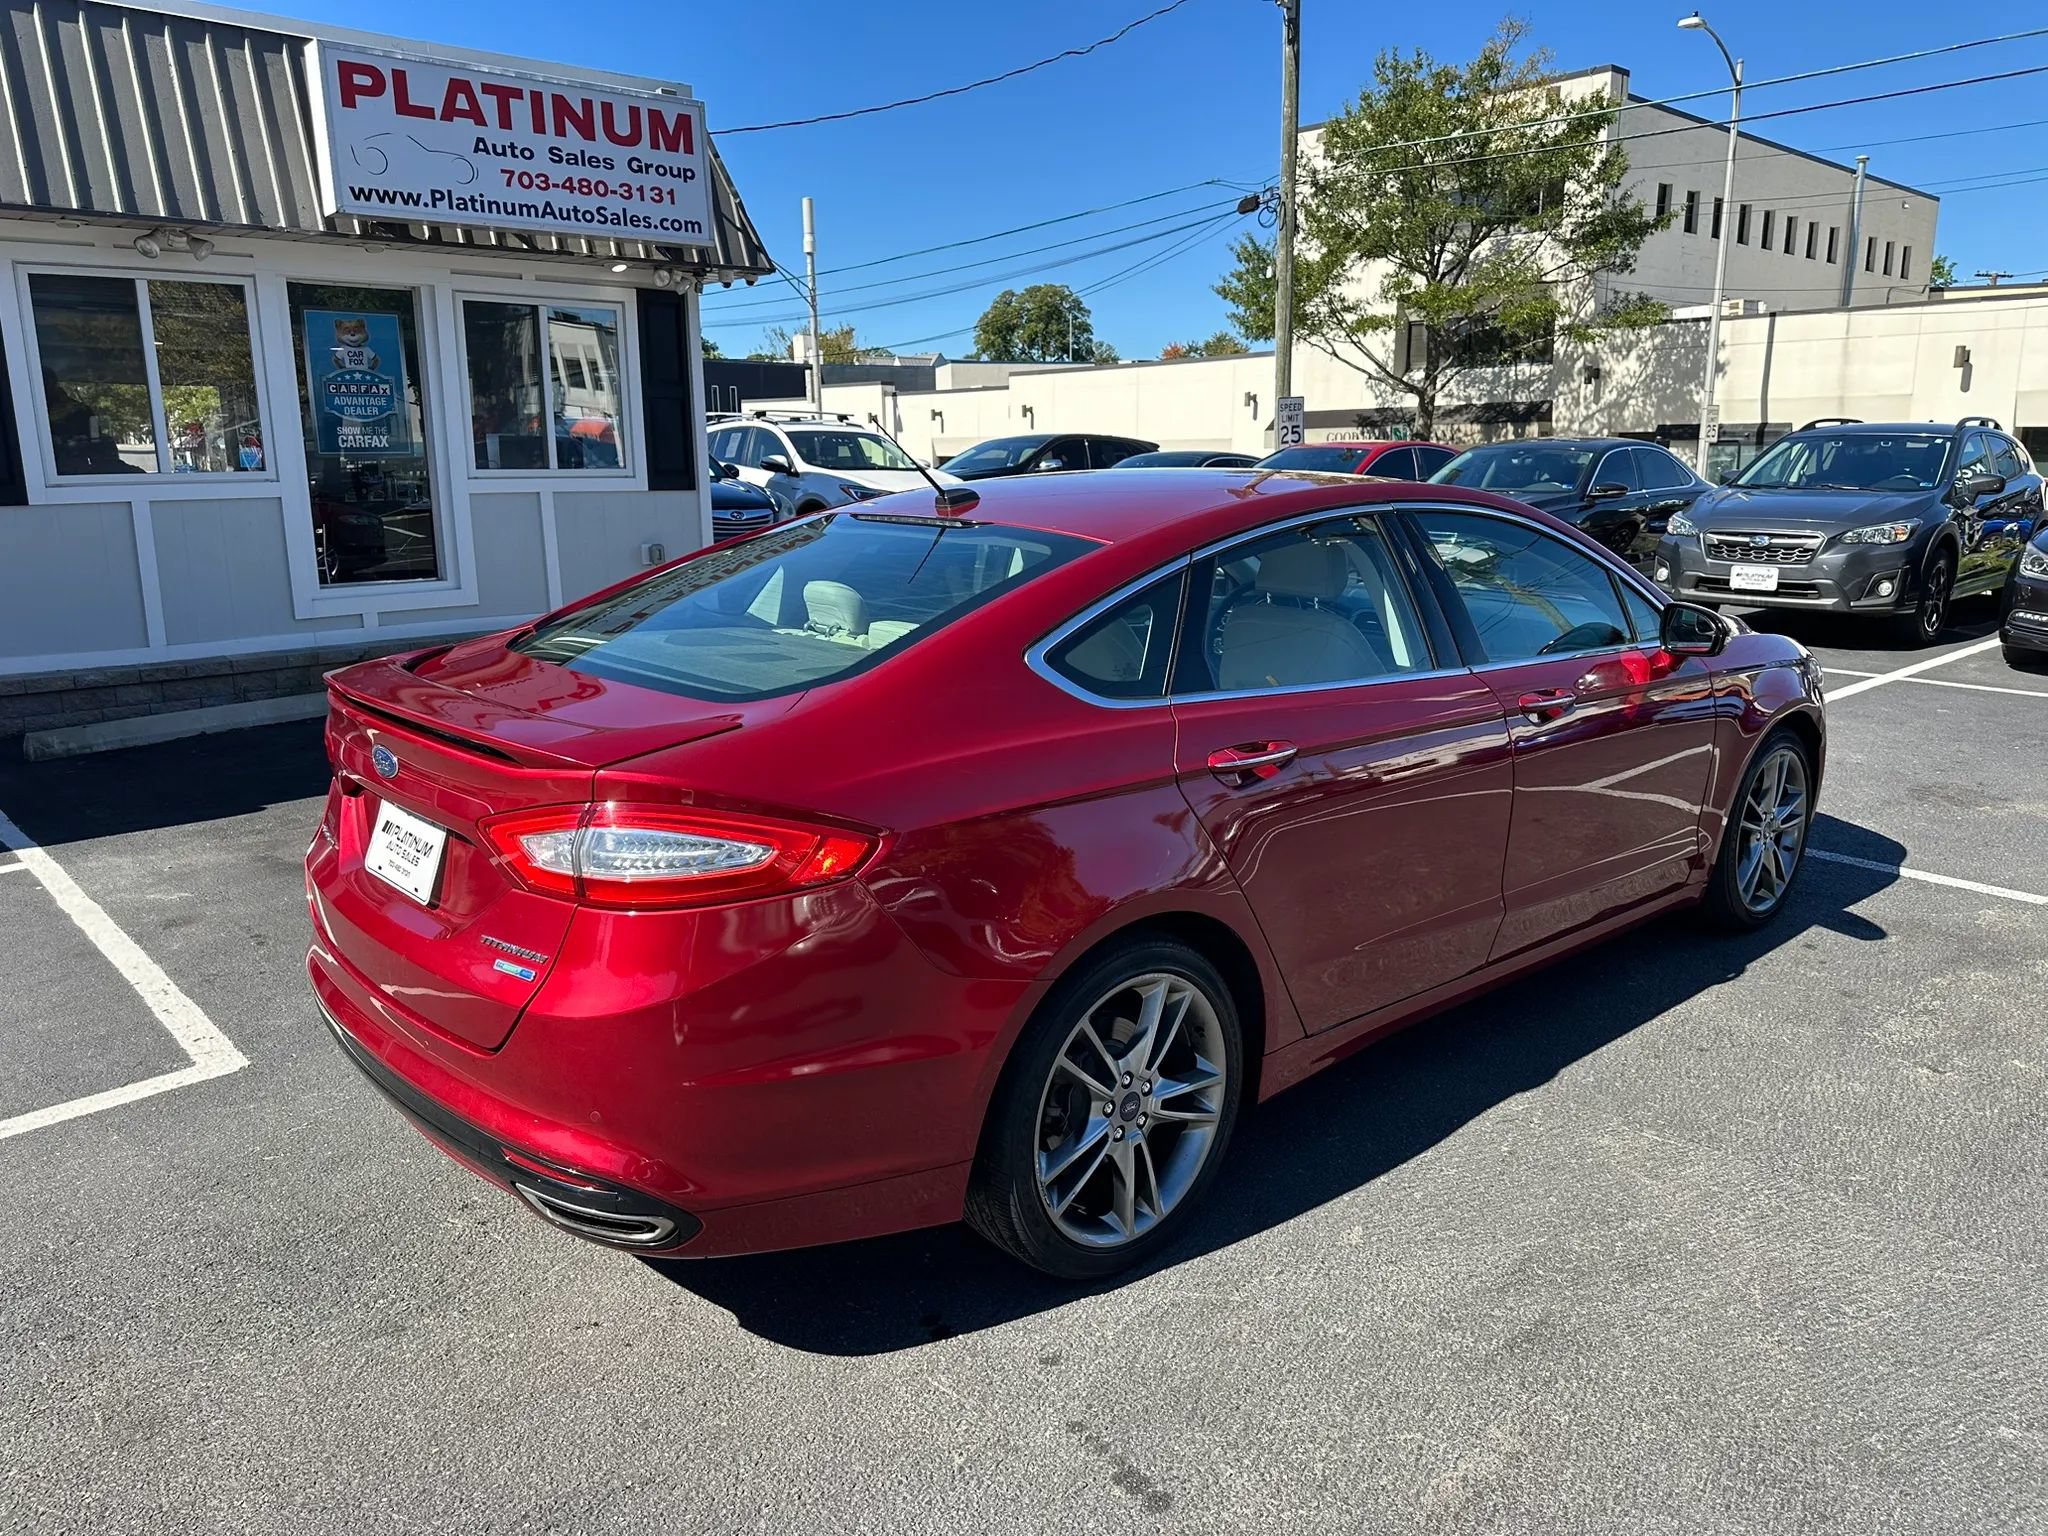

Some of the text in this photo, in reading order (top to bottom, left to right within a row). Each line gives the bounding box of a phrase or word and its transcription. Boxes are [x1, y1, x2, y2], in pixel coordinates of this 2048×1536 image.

[336, 59, 695, 156] PLATINUM
[472, 136, 696, 183] Auto Sales Group
[500, 168, 676, 206] 703-480-3131
[348, 184, 703, 235] www.PlatinumAutoSales.com
[347, 350, 364, 358] CAR
[348, 358, 365, 366] FOX
[329, 384, 390, 394] CARFAX
[334, 397, 387, 406] ADVANTAGE
[344, 407, 379, 416] DEALER
[1279, 402, 1302, 413] SPEED
[1281, 413, 1300, 423] LIMIT
[336, 426, 389, 435] SHOW ME THE
[1280, 424, 1301, 445] 25
[1706, 424, 1717, 438] 25
[338, 436, 389, 448] CARFAX
[391, 824, 434, 858] PLATINUM
